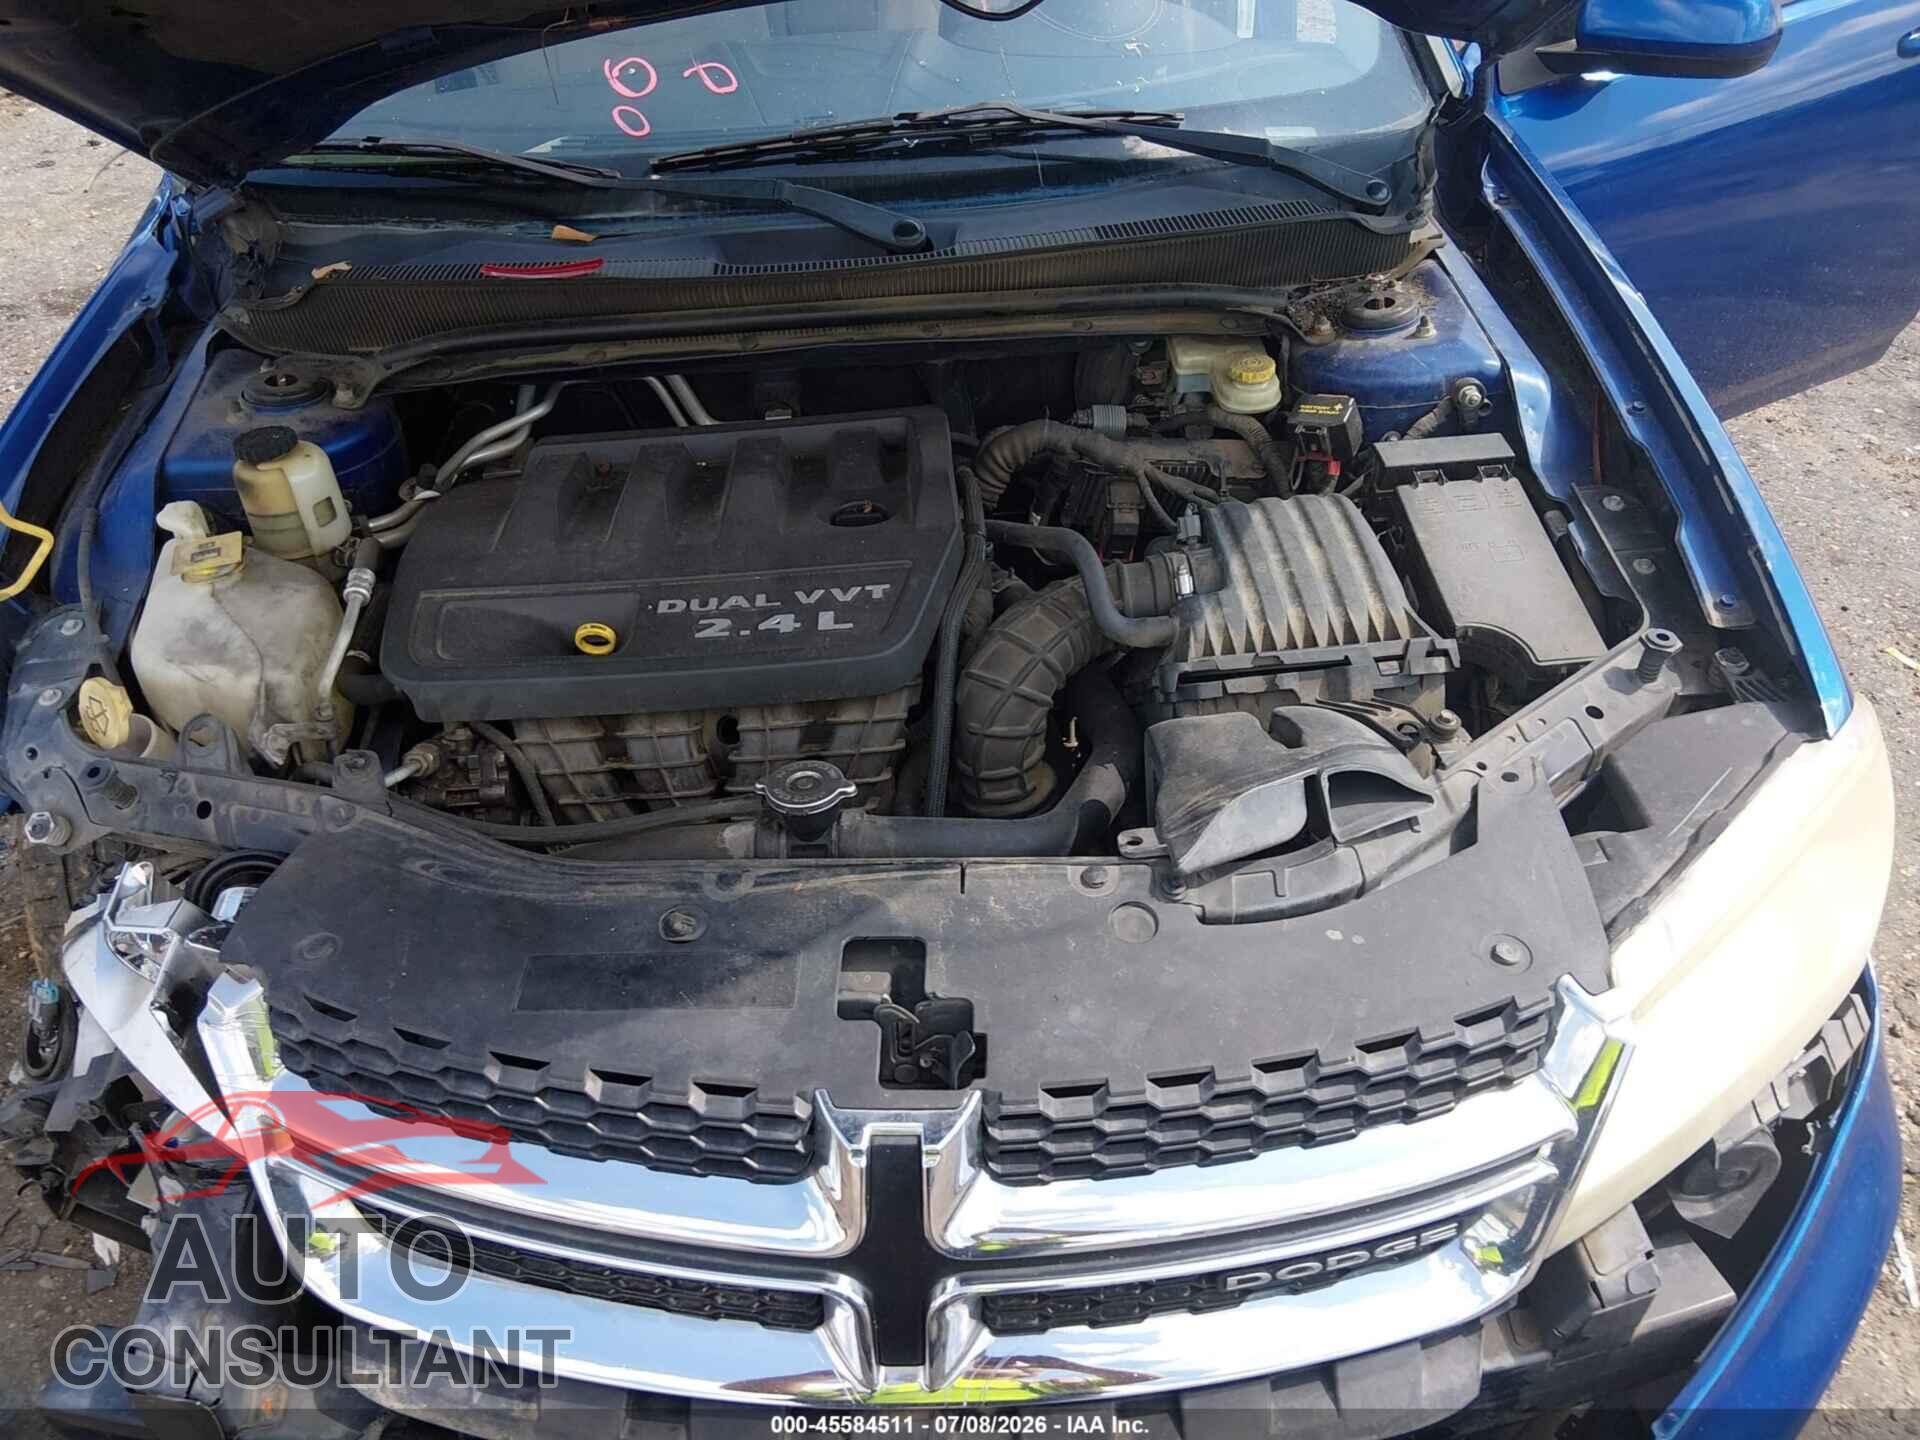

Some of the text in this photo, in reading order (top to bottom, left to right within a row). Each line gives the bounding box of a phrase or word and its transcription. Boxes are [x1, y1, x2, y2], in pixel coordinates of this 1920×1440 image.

[656, 583, 891, 614] DUAL VVT
[1226, 1222, 1459, 1291] DODGE
